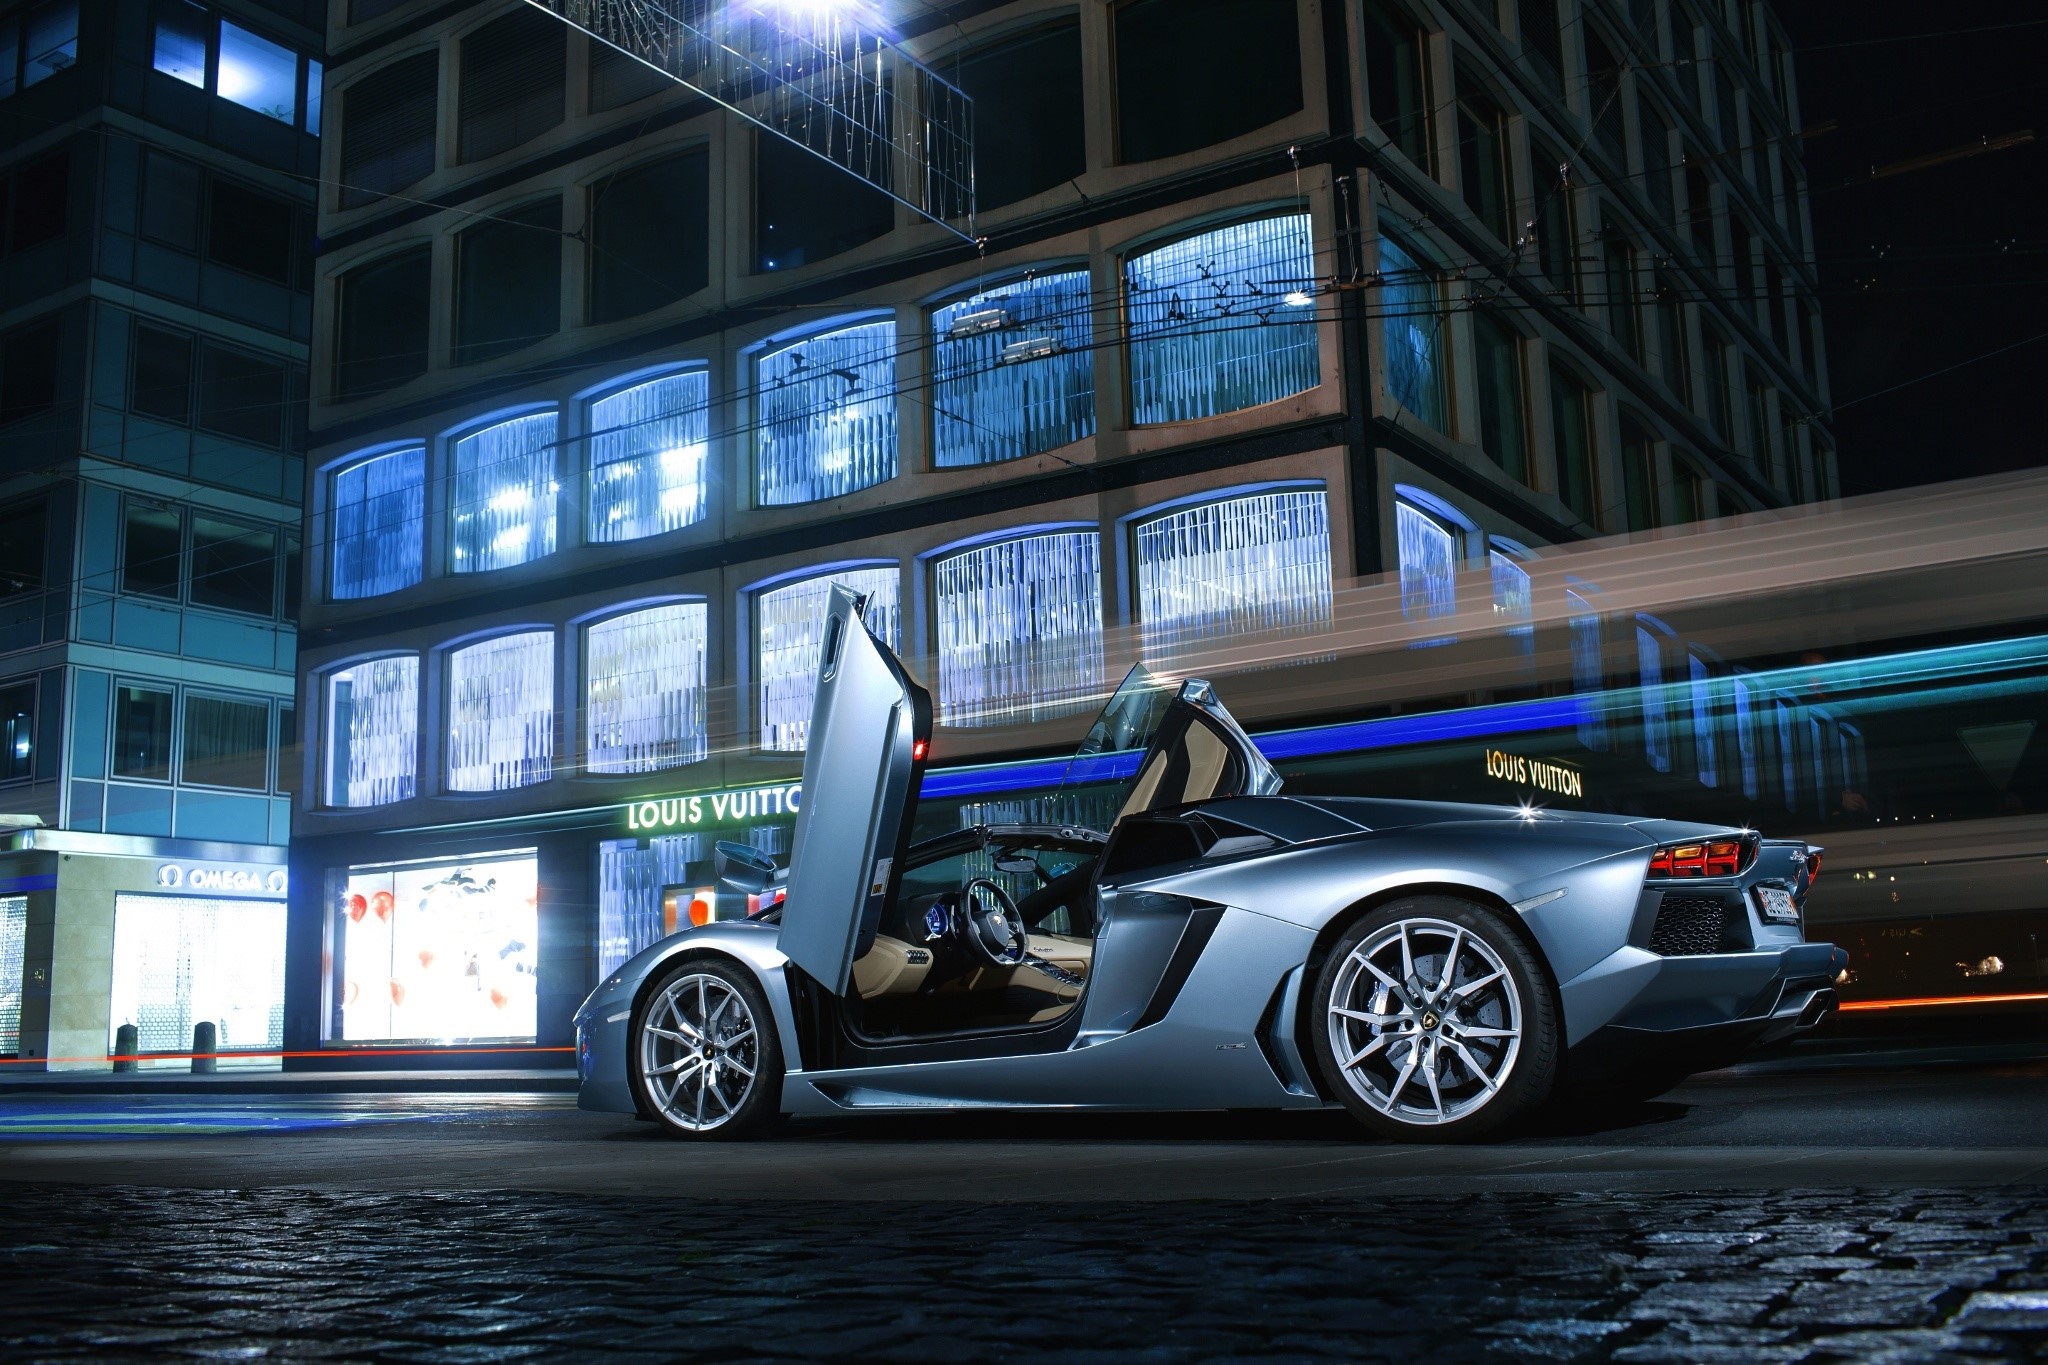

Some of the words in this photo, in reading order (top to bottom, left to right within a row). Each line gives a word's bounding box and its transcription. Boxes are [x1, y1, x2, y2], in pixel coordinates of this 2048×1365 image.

[1486, 748, 1526, 784] LOUIS
[1528, 760, 1582, 798] VUITTON
[628, 797, 702, 829] LOUIS
[711, 785, 802, 821] VUITTO
[187, 868, 262, 891] OMEGA
